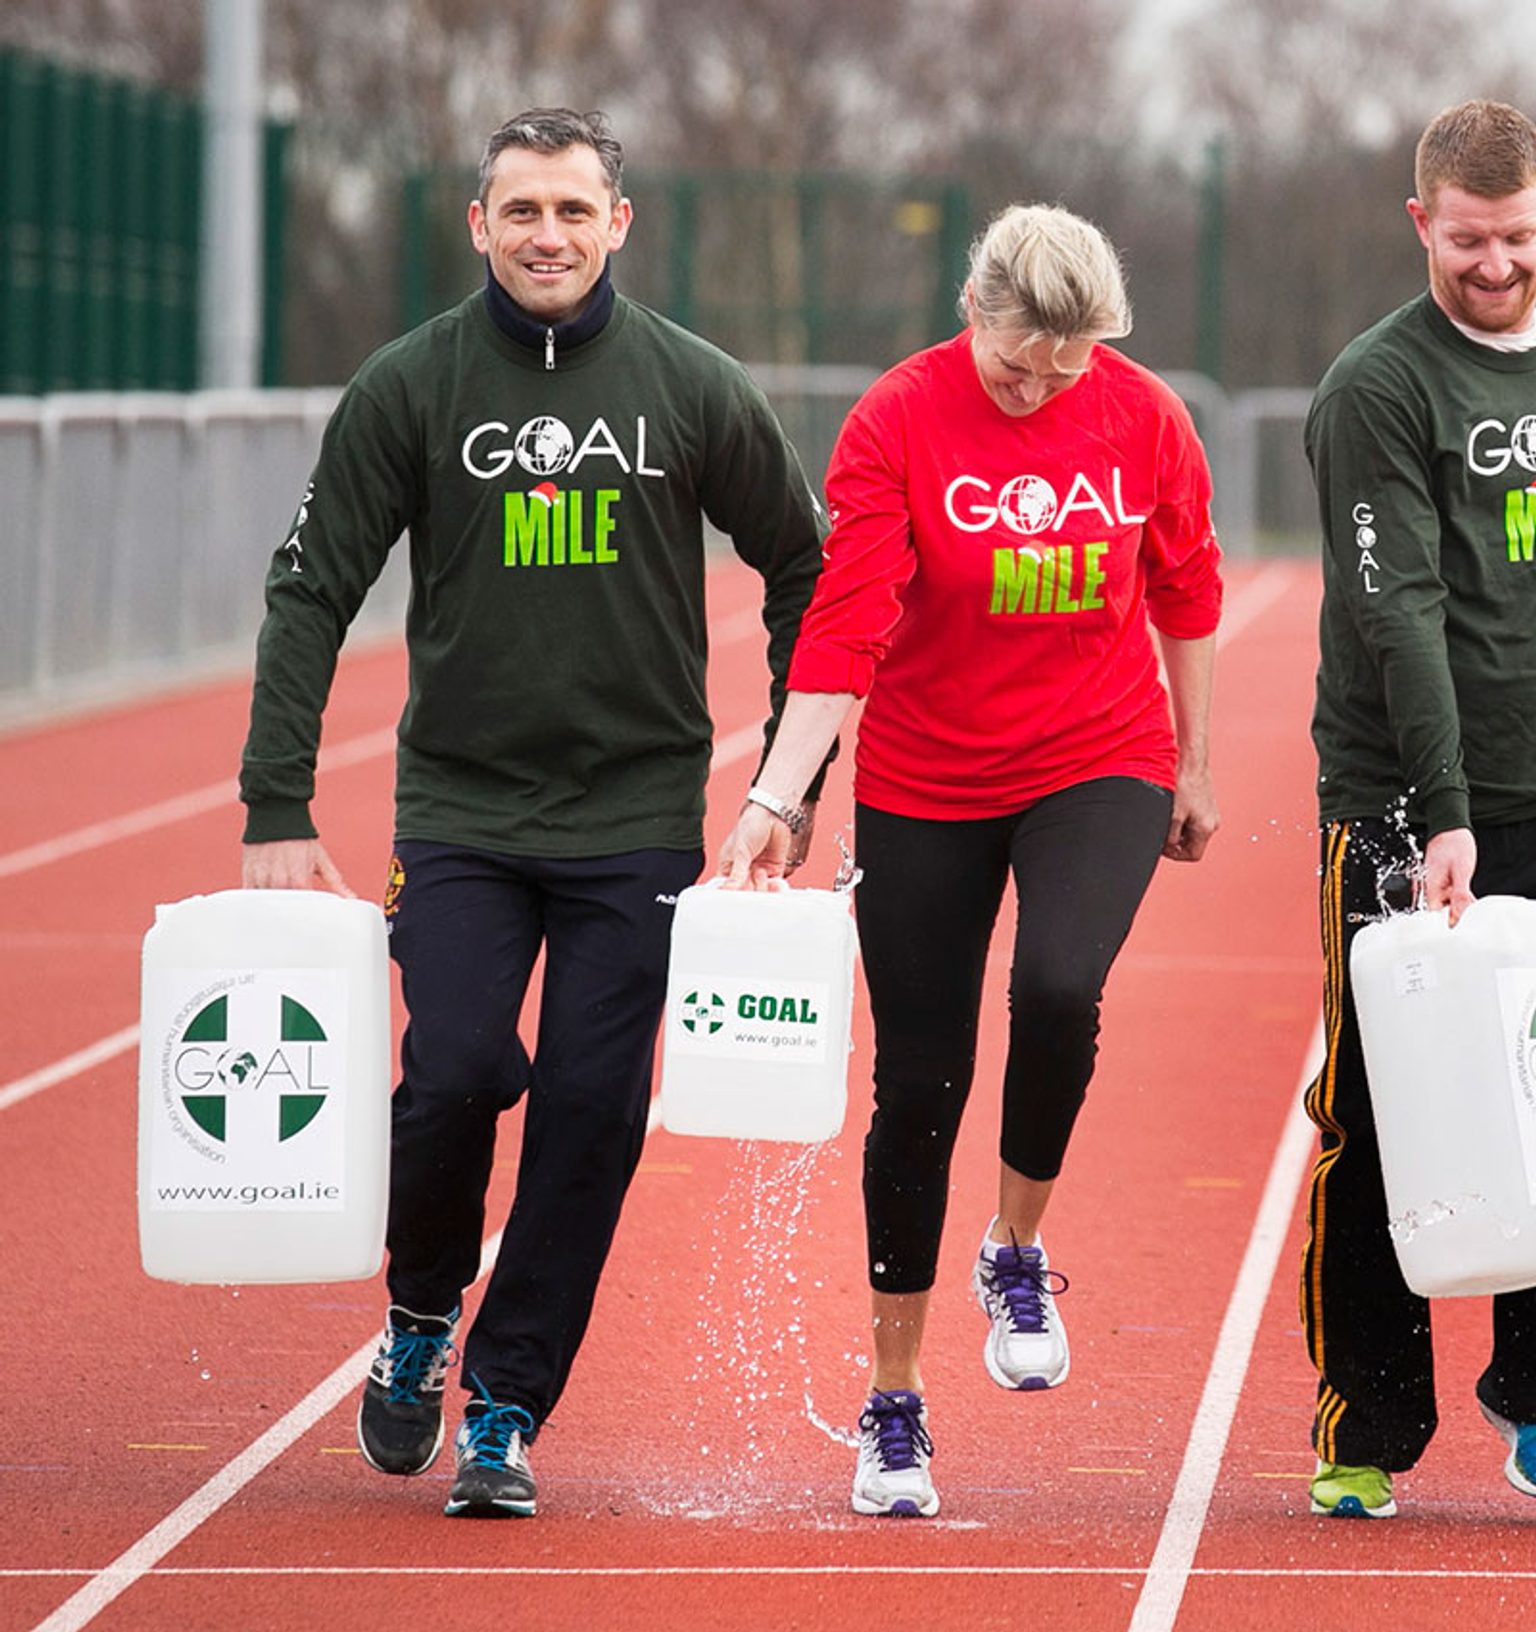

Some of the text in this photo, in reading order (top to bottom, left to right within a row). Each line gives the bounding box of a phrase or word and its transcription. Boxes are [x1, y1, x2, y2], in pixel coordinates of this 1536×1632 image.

[462, 415, 665, 480] GOAL
[503, 488, 621, 568] MILE
[944, 467, 1147, 534] GOAL
[989, 541, 1109, 615] MILE
[1352, 503, 1380, 594] GOAL
[734, 1032, 818, 1048] www.goal.ie
[737, 994, 818, 1024] GOAL
[174, 1045, 329, 1091] GOAL
[157, 1182, 340, 1204] www.goal.ie
